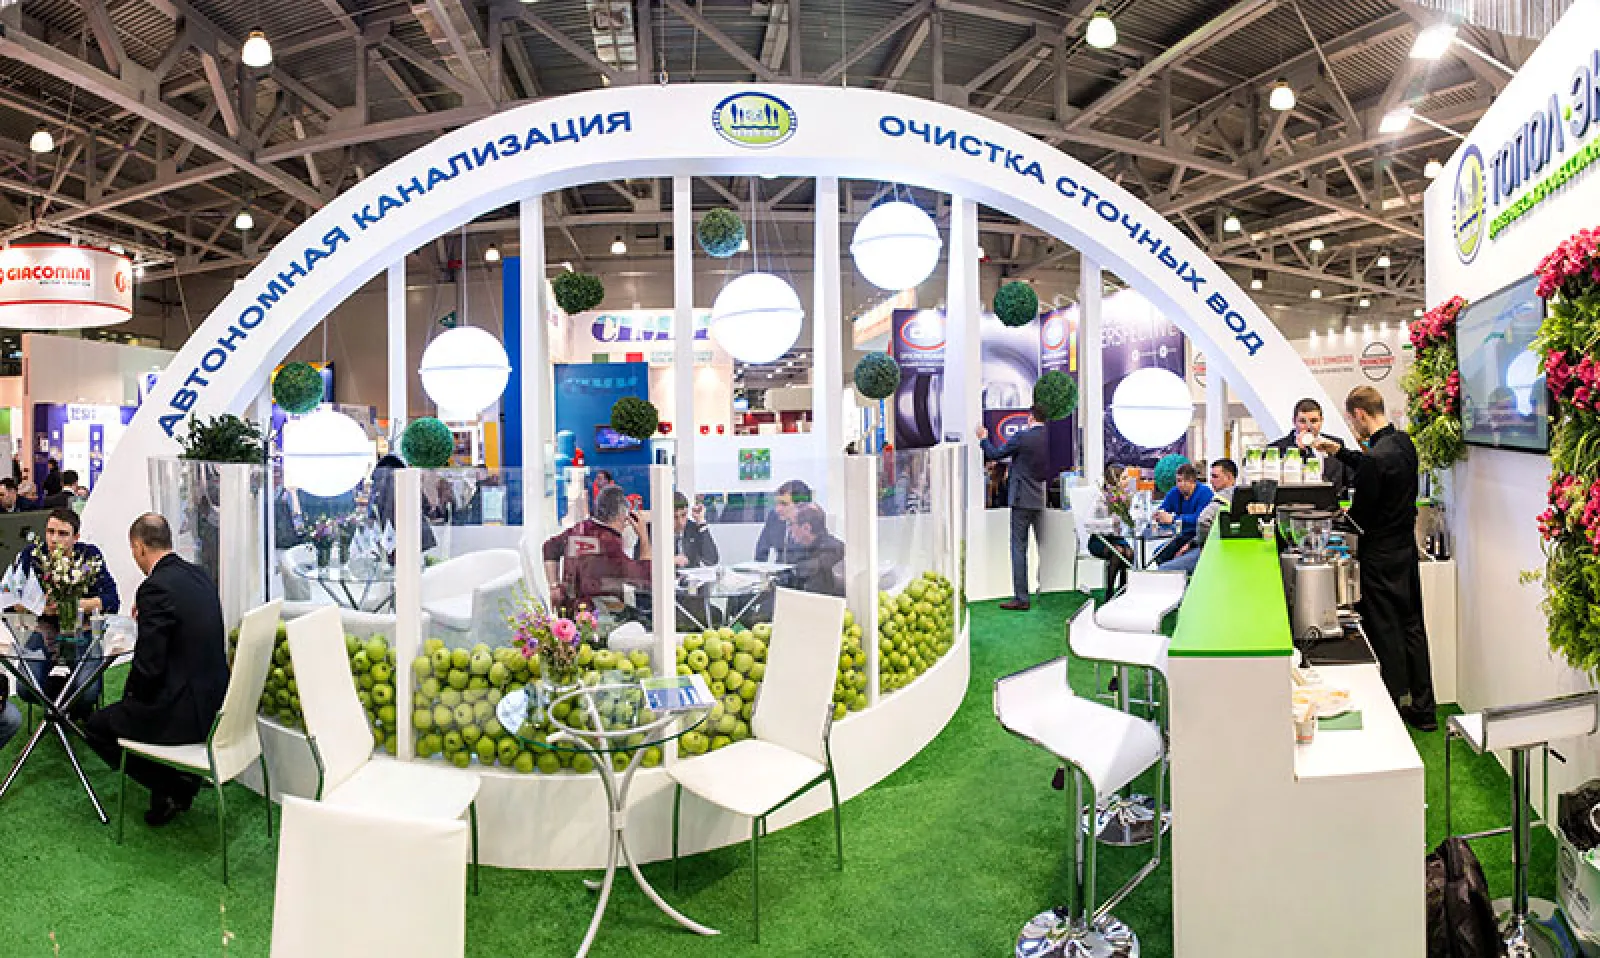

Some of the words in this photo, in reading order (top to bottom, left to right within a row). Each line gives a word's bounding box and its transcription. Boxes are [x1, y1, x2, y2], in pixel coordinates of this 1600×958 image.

[158, 226, 351, 437] АВТОНОМНАЯ
[351, 111, 632, 230] КАНАЛИЗАЦИЯ
[879, 115, 1045, 184] ОЧИСТКА
[1055, 176, 1206, 293] СТОЧНЫХ
[1206, 291, 1265, 356] ВОД
